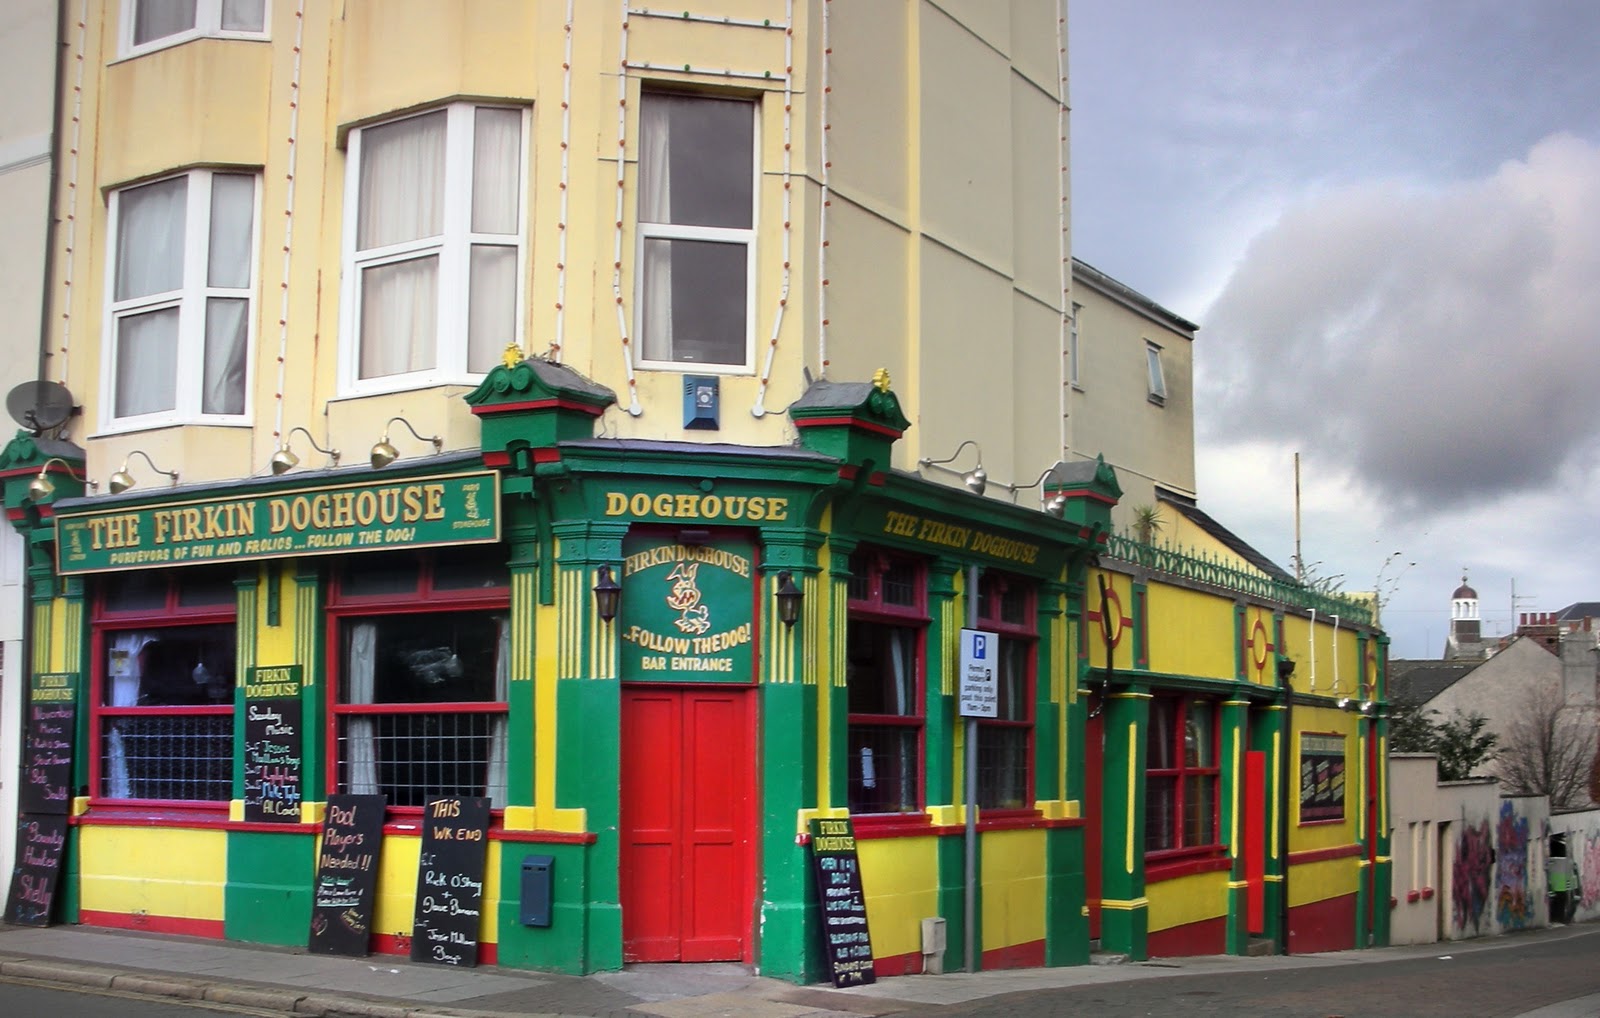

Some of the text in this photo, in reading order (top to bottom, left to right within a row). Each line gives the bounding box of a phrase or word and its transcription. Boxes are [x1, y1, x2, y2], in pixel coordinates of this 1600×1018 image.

[605, 492, 789, 521] DOGHOUSE
[88, 484, 446, 550] THE FIRKIN DOGHOUSE
[109, 548, 170, 564] PURVEYORS
[174, 546, 188, 559] OF
[191, 544, 213, 558] FUN
[216, 541, 242, 556] AND
[358, 529, 381, 545] THE
[385, 527, 416, 542] DOG!
[883, 510, 1039, 565] THE FIRKIN DOGHOUSE
[625, 543, 750, 579] FIRKIN DOGHOUSE
[694, 637, 721, 654] THE
[720, 622, 752, 651] DOG!
[975, 636, 984, 658] P
[642, 657, 733, 672] BAR ENTRANCE
[40, 675, 68, 687] FIRKIN
[255, 669, 291, 682] FIRKIN
[32, 688, 73, 700] DOGHOUSE
[246, 683, 299, 697] DOGHOUSE
[249, 706, 282, 726] Sunday
[265, 723, 294, 736] Music
[328, 805, 357, 826] Pool
[434, 826, 482, 841] WK END
[820, 821, 848, 834] FIRKIN
[815, 836, 856, 851] DOGHOUSE
[320, 854, 359, 870] Needed
